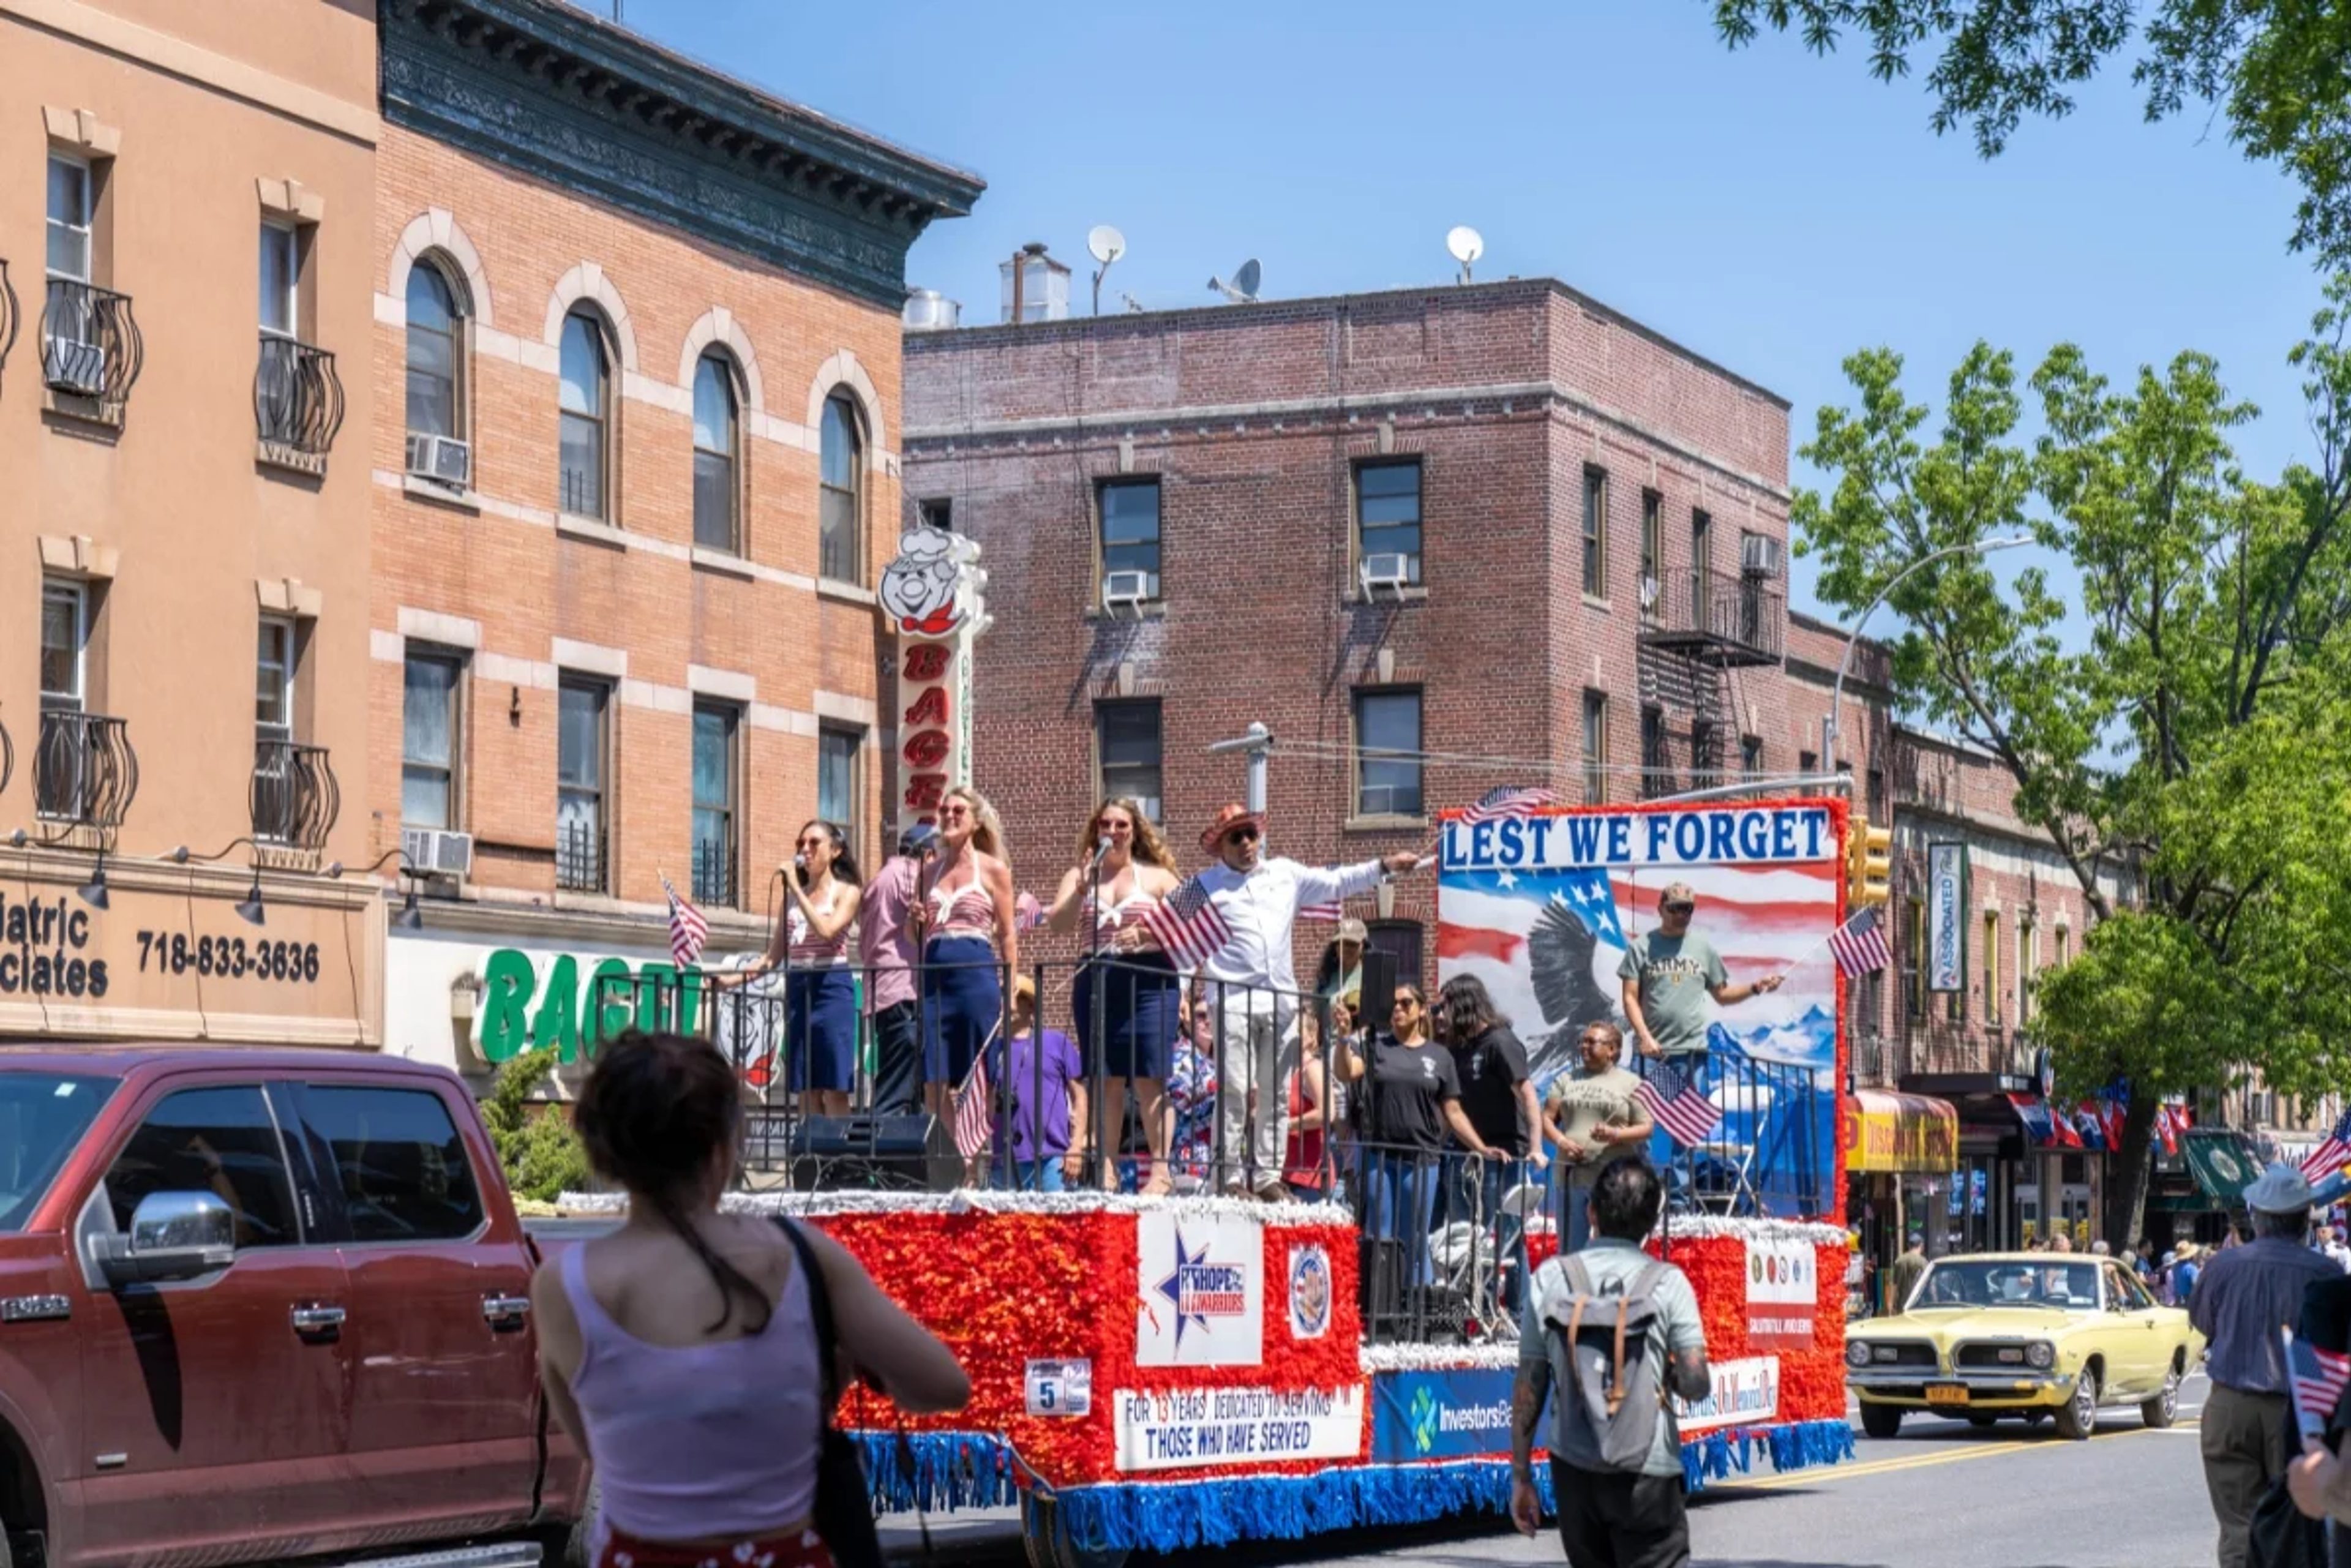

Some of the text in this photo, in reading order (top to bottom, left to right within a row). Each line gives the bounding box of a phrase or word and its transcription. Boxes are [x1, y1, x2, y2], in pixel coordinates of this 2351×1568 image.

[1445, 811, 1826, 866] LEST WE FORGET
[1941, 879, 1954, 969] ASSOCIATED
[0, 943, 108, 998] ciates
[137, 930, 320, 983] 718-833-3636
[1040, 1381, 1054, 1409] 5
[1126, 1397, 1150, 1422] FOR
[1157, 1396, 1168, 1423] 13
[1214, 1394, 1265, 1420] DEDICATED
[1267, 1392, 1279, 1417] TO
[1283, 1390, 1332, 1417] SERVING
[1146, 1422, 1311, 1459] THOSE WHO HAVE SERVED
